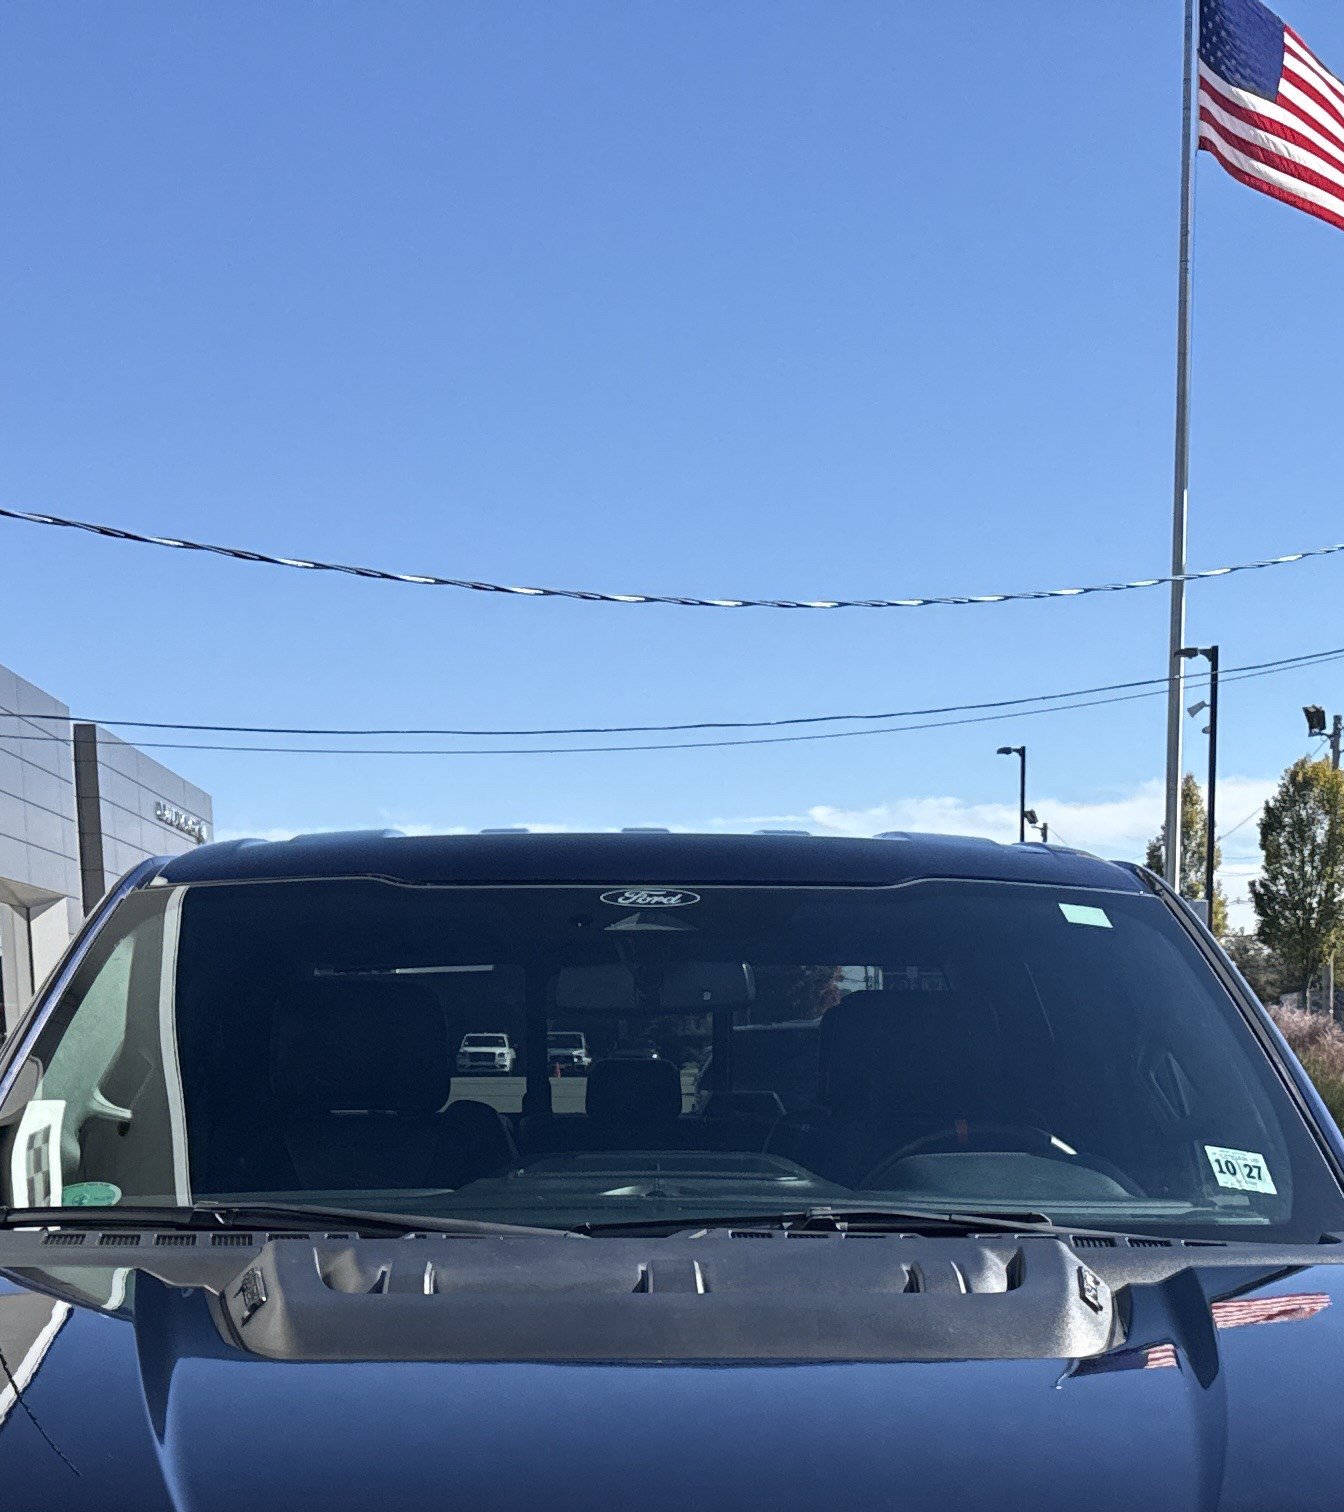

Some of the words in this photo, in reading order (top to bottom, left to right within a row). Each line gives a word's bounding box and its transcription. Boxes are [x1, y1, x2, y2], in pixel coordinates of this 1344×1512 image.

[617, 889, 682, 904] Ford
[1215, 1158, 1237, 1176] 10
[1243, 1163, 1262, 1180] 27
